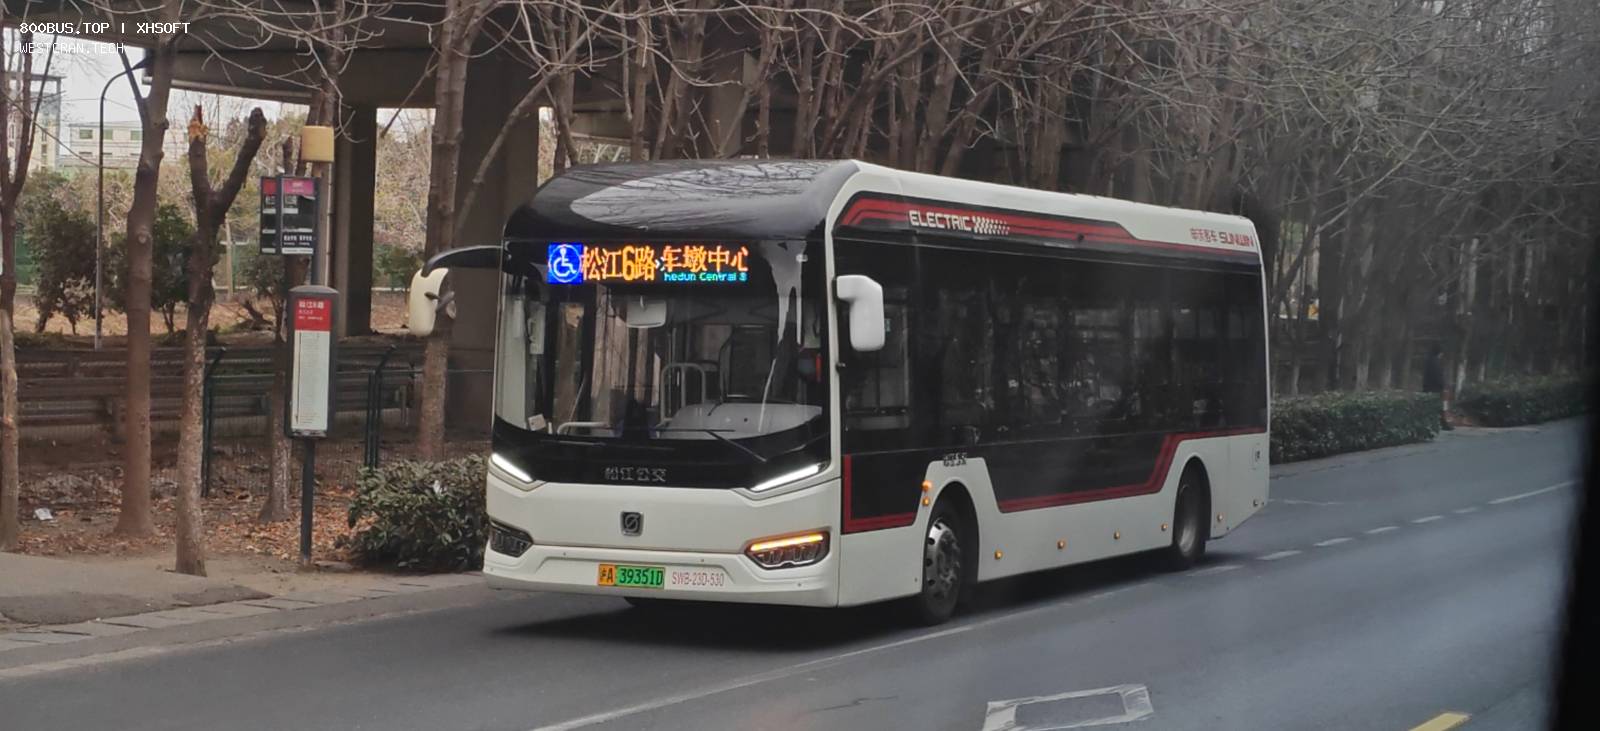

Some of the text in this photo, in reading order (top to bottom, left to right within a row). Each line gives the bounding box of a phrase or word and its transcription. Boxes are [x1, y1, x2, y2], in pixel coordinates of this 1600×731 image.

[909, 210, 972, 231] ELECTRIC
[582, 245, 749, 281] 松江6路 车墩中心
[699, 272, 736, 281] Central
[619, 567, 664, 586] 39351D
